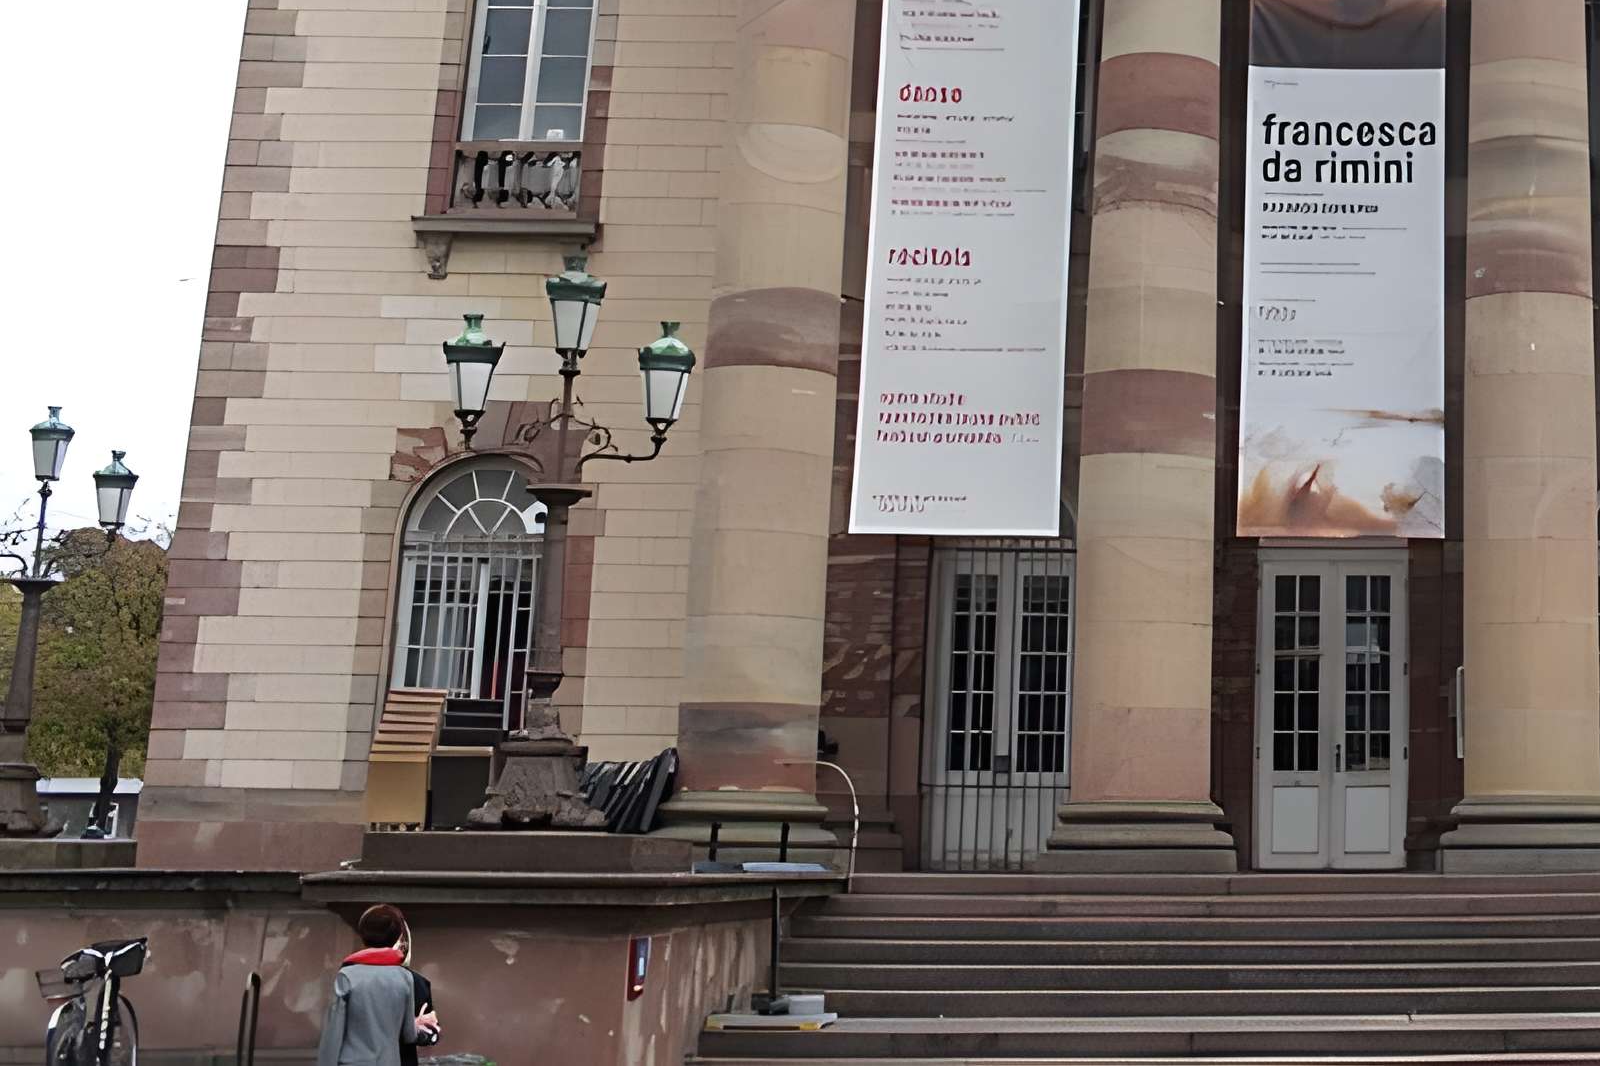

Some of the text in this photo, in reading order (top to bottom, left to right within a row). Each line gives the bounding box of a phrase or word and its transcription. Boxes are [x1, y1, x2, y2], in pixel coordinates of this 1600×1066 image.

[1262, 113, 1437, 146] francesca
[1262, 150, 1414, 183] da rimini
